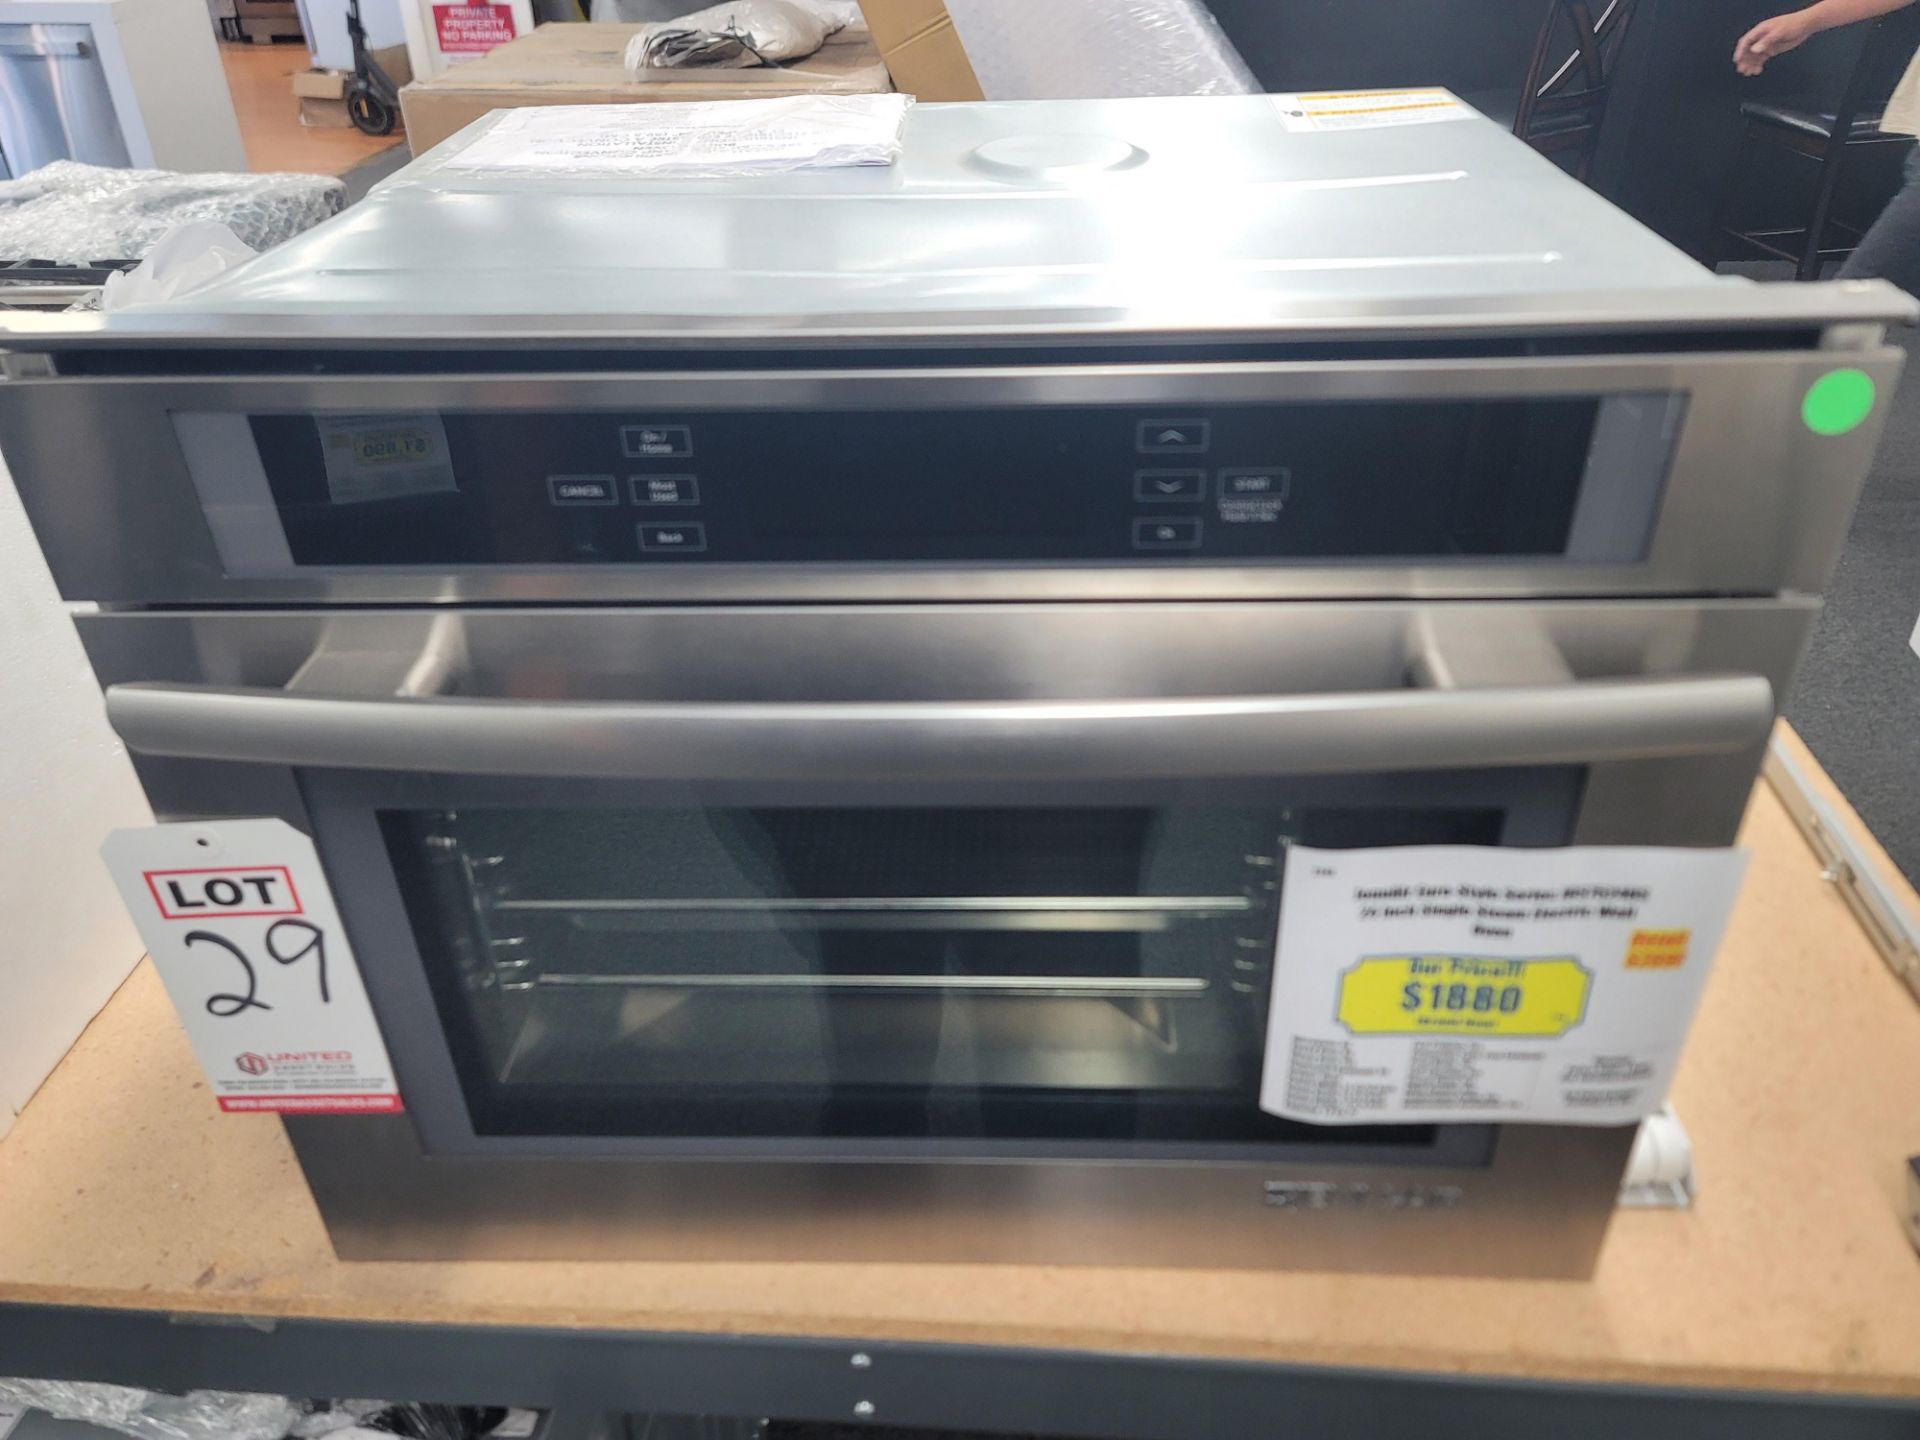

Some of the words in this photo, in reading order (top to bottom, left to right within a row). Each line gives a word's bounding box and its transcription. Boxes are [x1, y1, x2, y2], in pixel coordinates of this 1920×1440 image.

[449, 7, 496, 18] PRIVATE
[445, 18, 506, 30] PROPERTY
[442, 30, 461, 41] NO
[463, 29, 513, 42] PARKING
[166, 877, 277, 908] LOT
[184, 918, 330, 1017] 29
[1401, 980, 1523, 1014] $1880
[266, 1051, 353, 1062] UNITED
